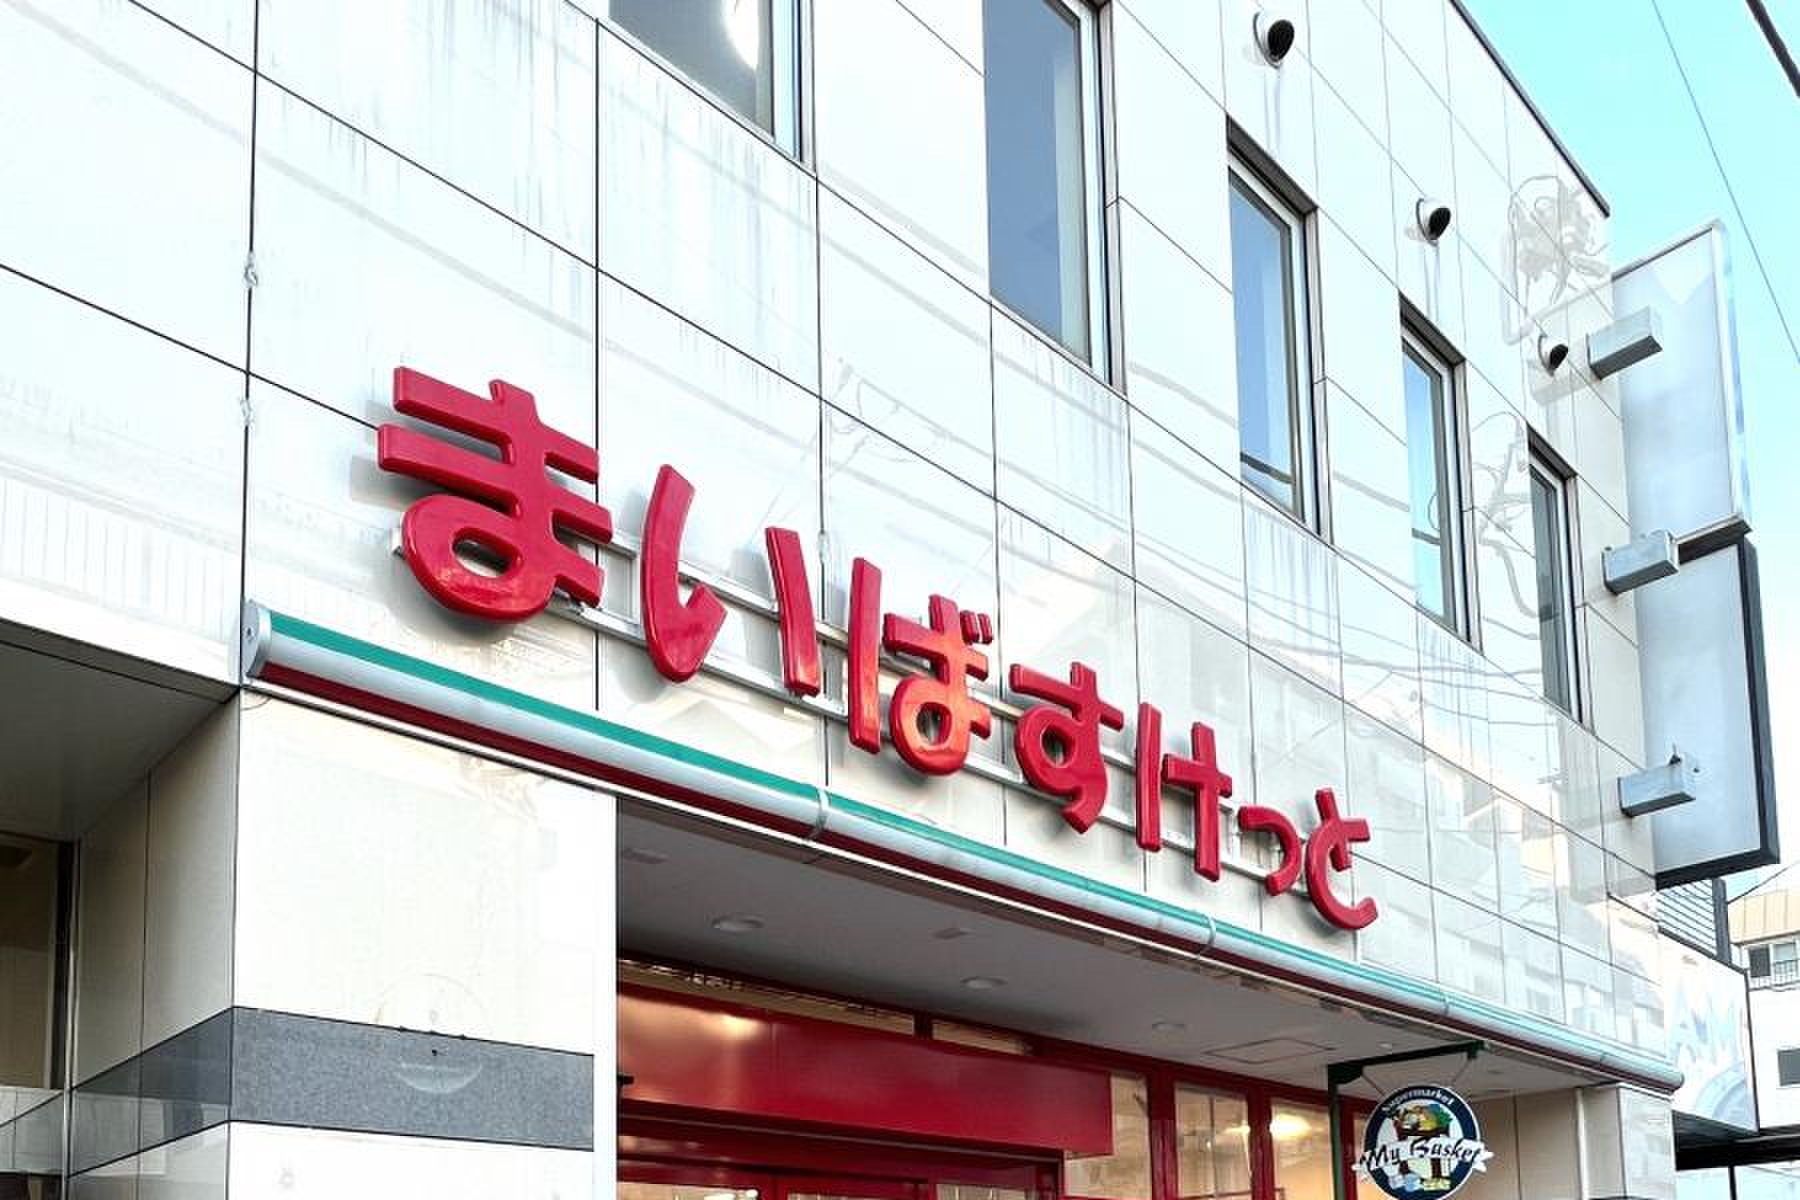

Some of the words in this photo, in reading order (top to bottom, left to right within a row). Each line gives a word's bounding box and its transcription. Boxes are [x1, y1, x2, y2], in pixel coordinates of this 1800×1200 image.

[378, 366, 1377, 930] まいばすけっと
[1410, 1137, 1481, 1163] Basket
